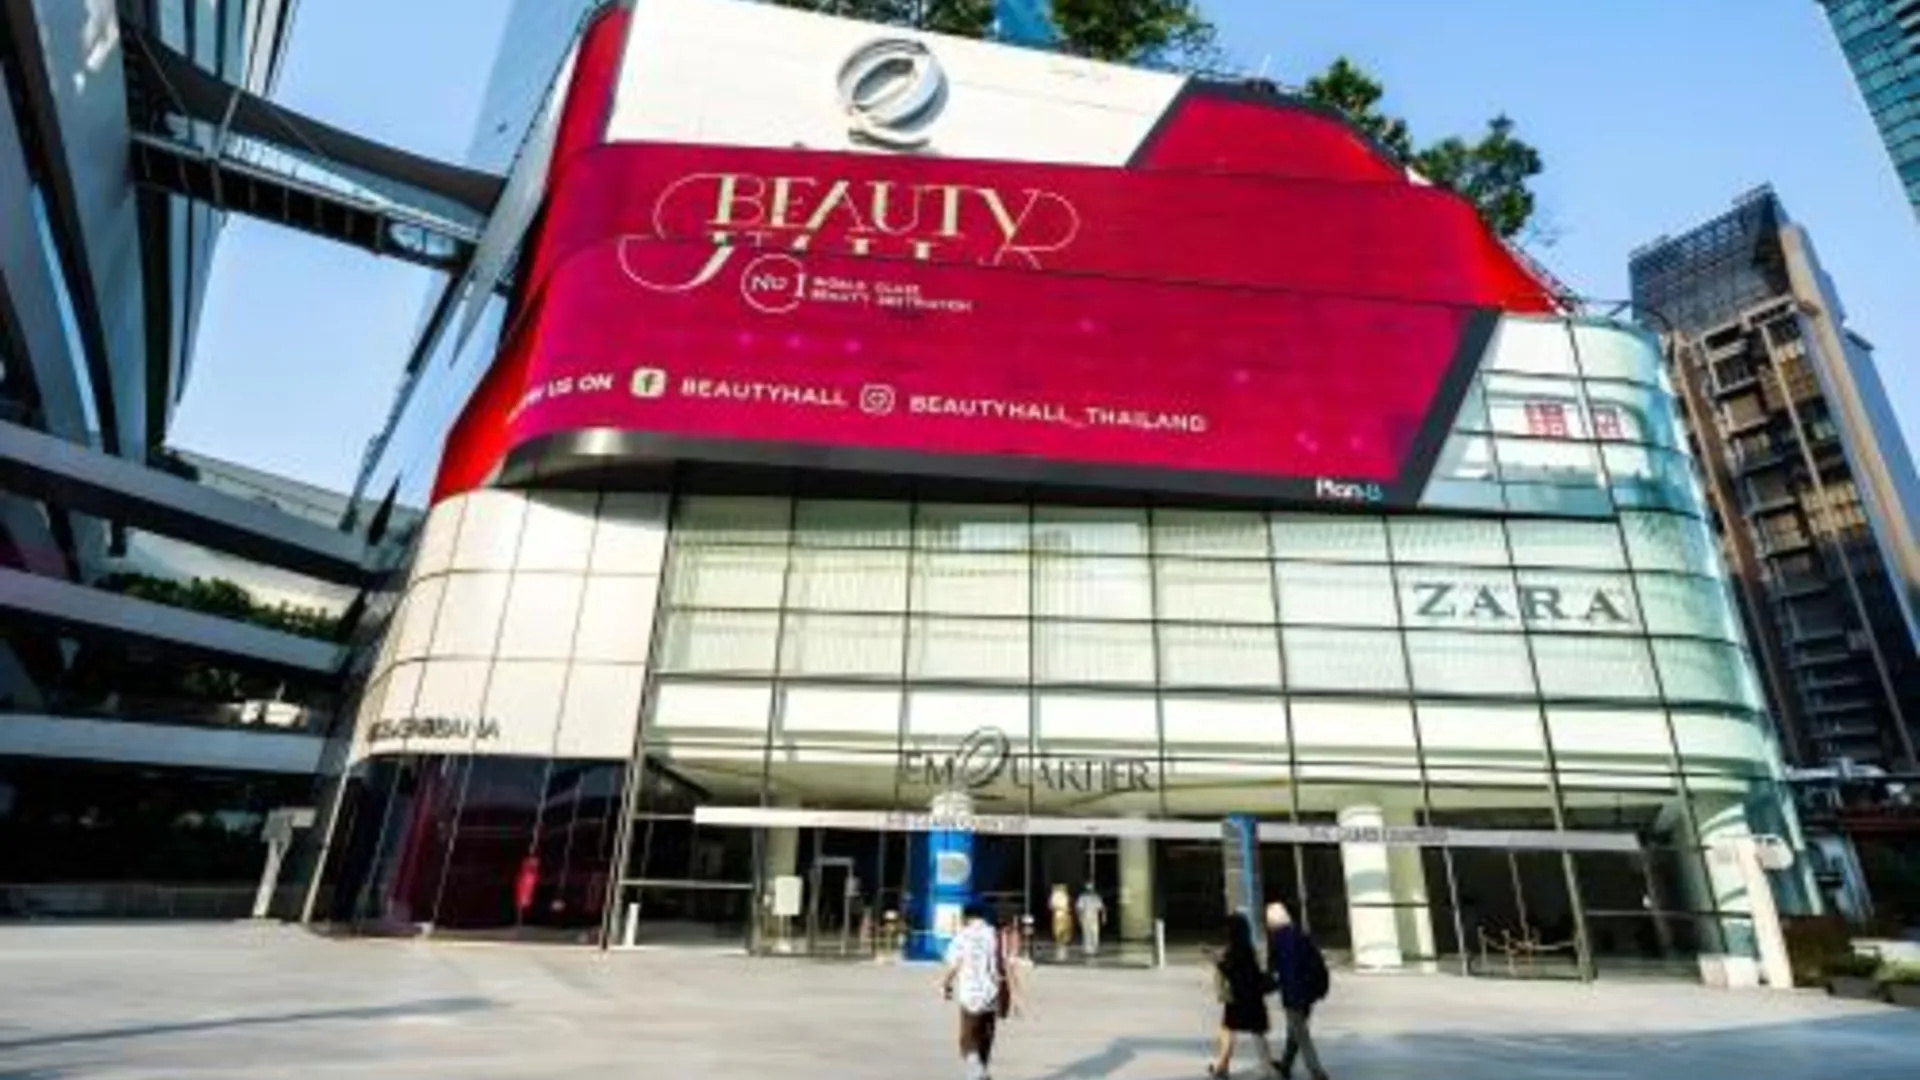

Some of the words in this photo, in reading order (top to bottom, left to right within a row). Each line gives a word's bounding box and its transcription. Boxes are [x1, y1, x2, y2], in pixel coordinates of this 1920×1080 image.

[702, 173, 1036, 238] BEAUTY
[579, 373, 613, 391] ON
[680, 376, 848, 407] BEAUTYHALL
[909, 394, 1207, 433] BEAUTYHALL_THAILAND
[1413, 581, 1631, 624] ZARA
